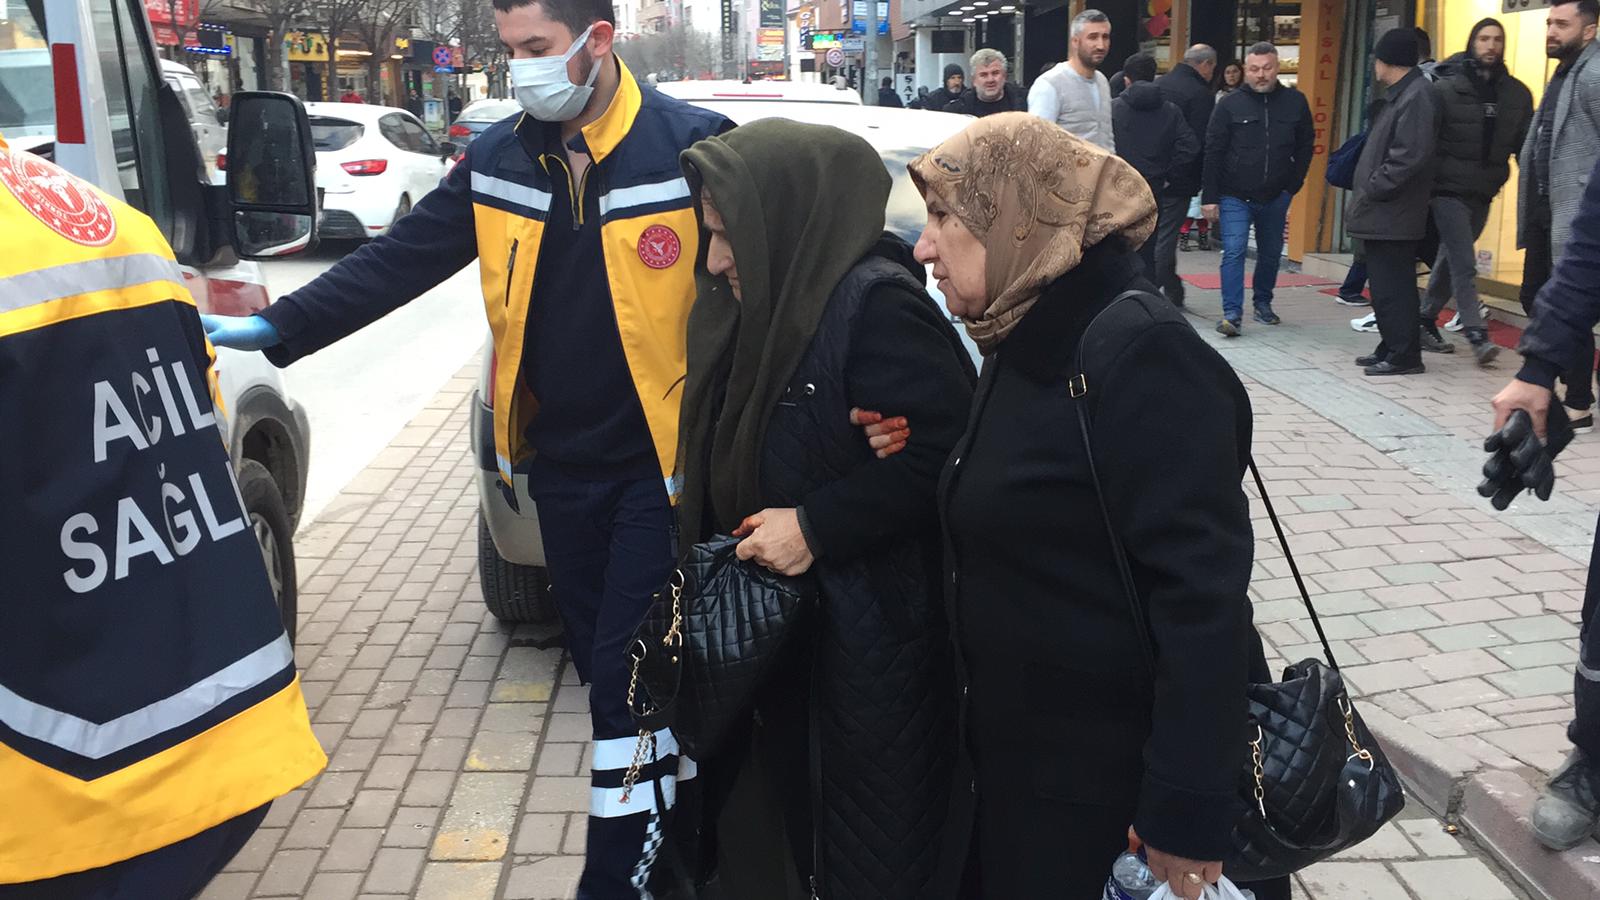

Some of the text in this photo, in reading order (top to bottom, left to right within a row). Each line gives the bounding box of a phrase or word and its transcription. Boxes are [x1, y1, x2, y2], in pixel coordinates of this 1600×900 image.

[904, 75, 913, 106] ŞAT
[1312, 96, 1327, 155] LOTO
[94, 347, 216, 463] ACİL
